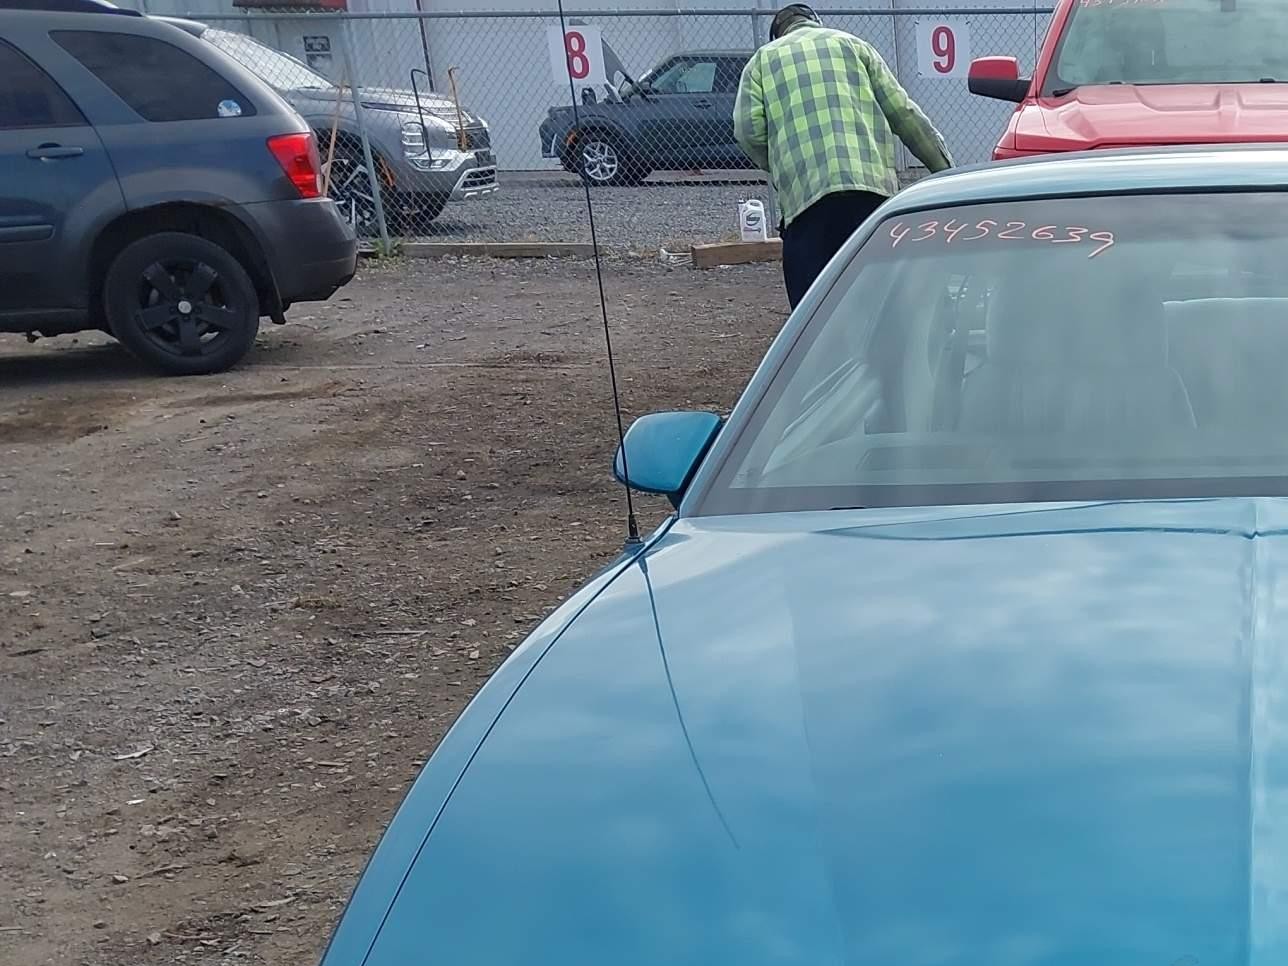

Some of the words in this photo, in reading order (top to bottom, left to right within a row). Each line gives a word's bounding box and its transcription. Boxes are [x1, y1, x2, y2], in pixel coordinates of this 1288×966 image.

[564, 31, 590, 79] 8
[932, 26, 956, 74] 9
[889, 218, 1115, 259] 43452639
